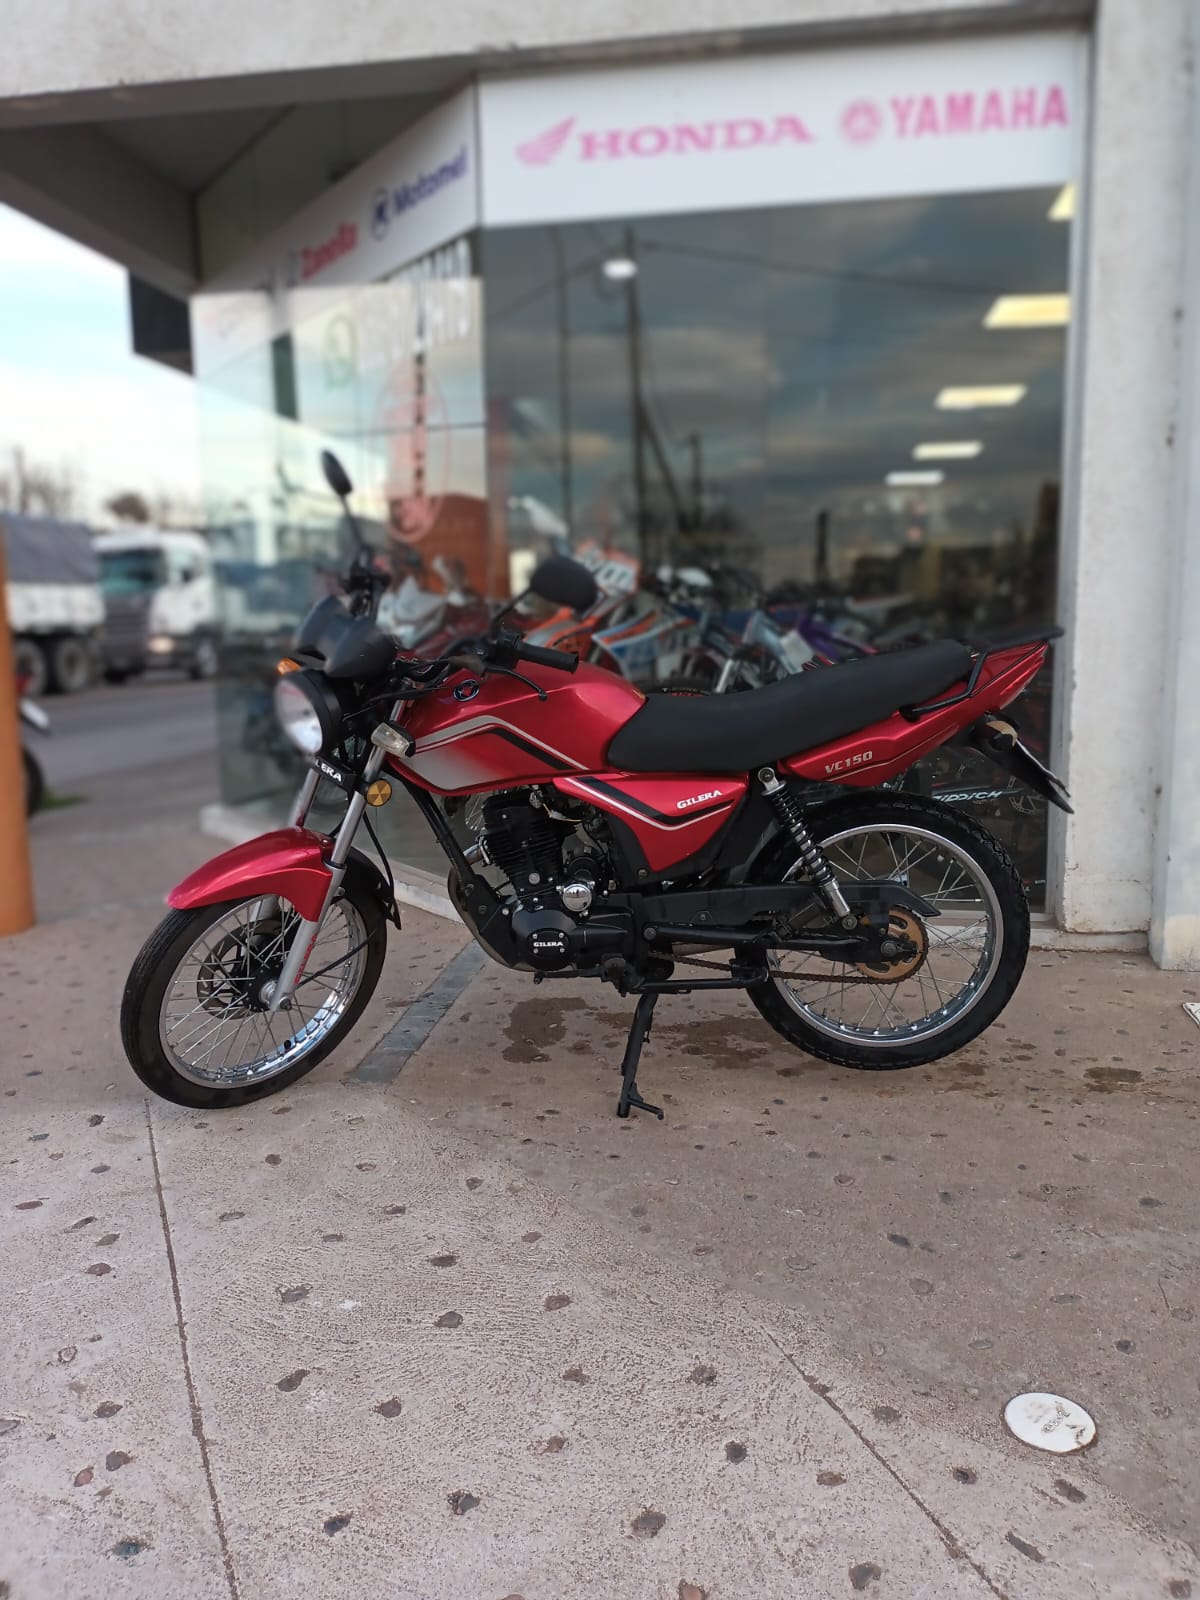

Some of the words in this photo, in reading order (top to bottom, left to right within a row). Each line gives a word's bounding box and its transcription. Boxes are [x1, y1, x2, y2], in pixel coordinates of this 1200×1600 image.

[888, 84, 1069, 137] YAMAHA
[579, 113, 813, 161] HONDA
[315, 759, 342, 782] LERA
[676, 789, 723, 809] GILERA
